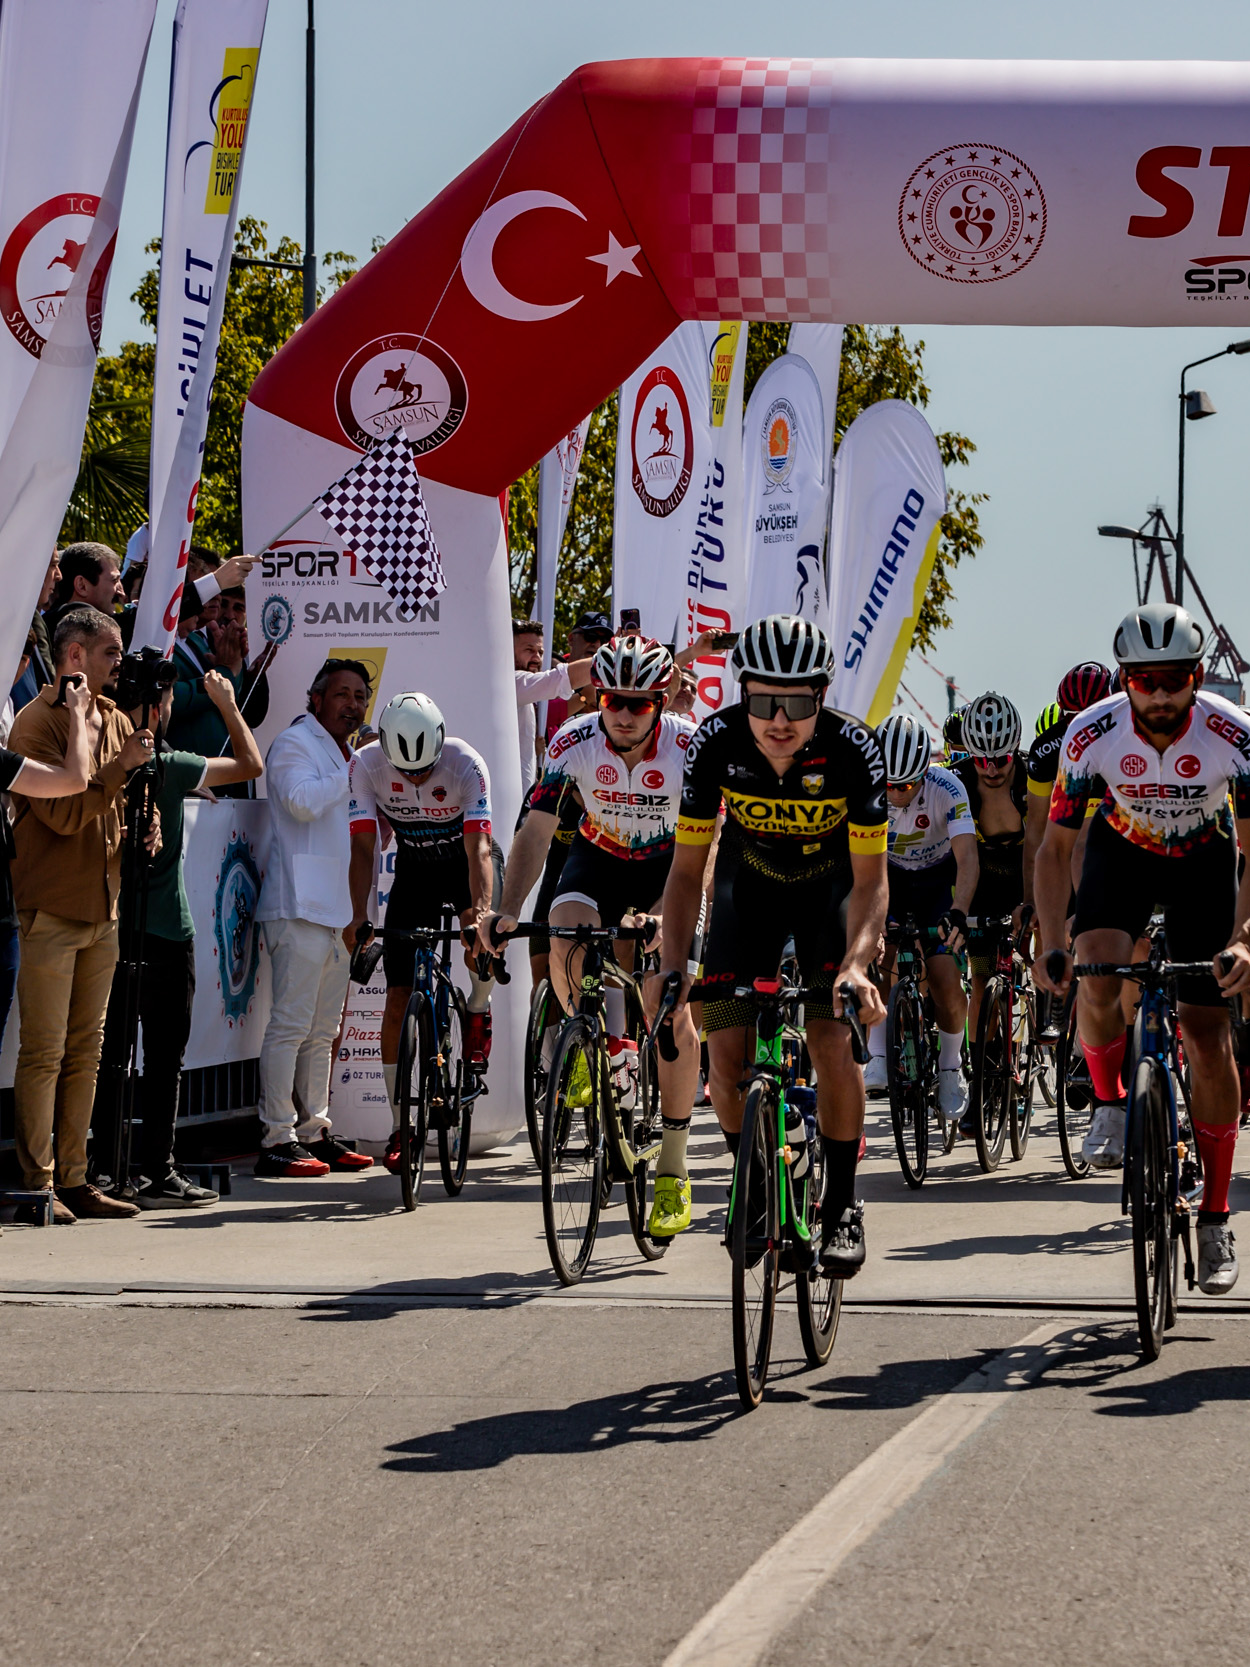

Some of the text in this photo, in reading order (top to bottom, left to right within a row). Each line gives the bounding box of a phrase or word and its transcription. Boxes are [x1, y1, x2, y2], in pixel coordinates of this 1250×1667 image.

[925, 169, 1020, 261] TÜRKİYE CUMHURİYETİ GENÇLİK VE SPOR BAKANLIĞI
[372, 404, 440, 435] SAMSUN
[768, 502, 791, 513] SAMSUN
[843, 487, 926, 675] SHIMANO
[682, 716, 728, 776] KONYA
[839, 719, 887, 786] KONYA
[598, 765, 617, 784] GSK
[1122, 756, 1146, 776] GSK
[591, 788, 671, 806] GEBIZ
[1115, 783, 1209, 800] GEBIZ
[384, 803, 461, 817] SPOR TOTO
[729, 797, 841, 824] KONYA
